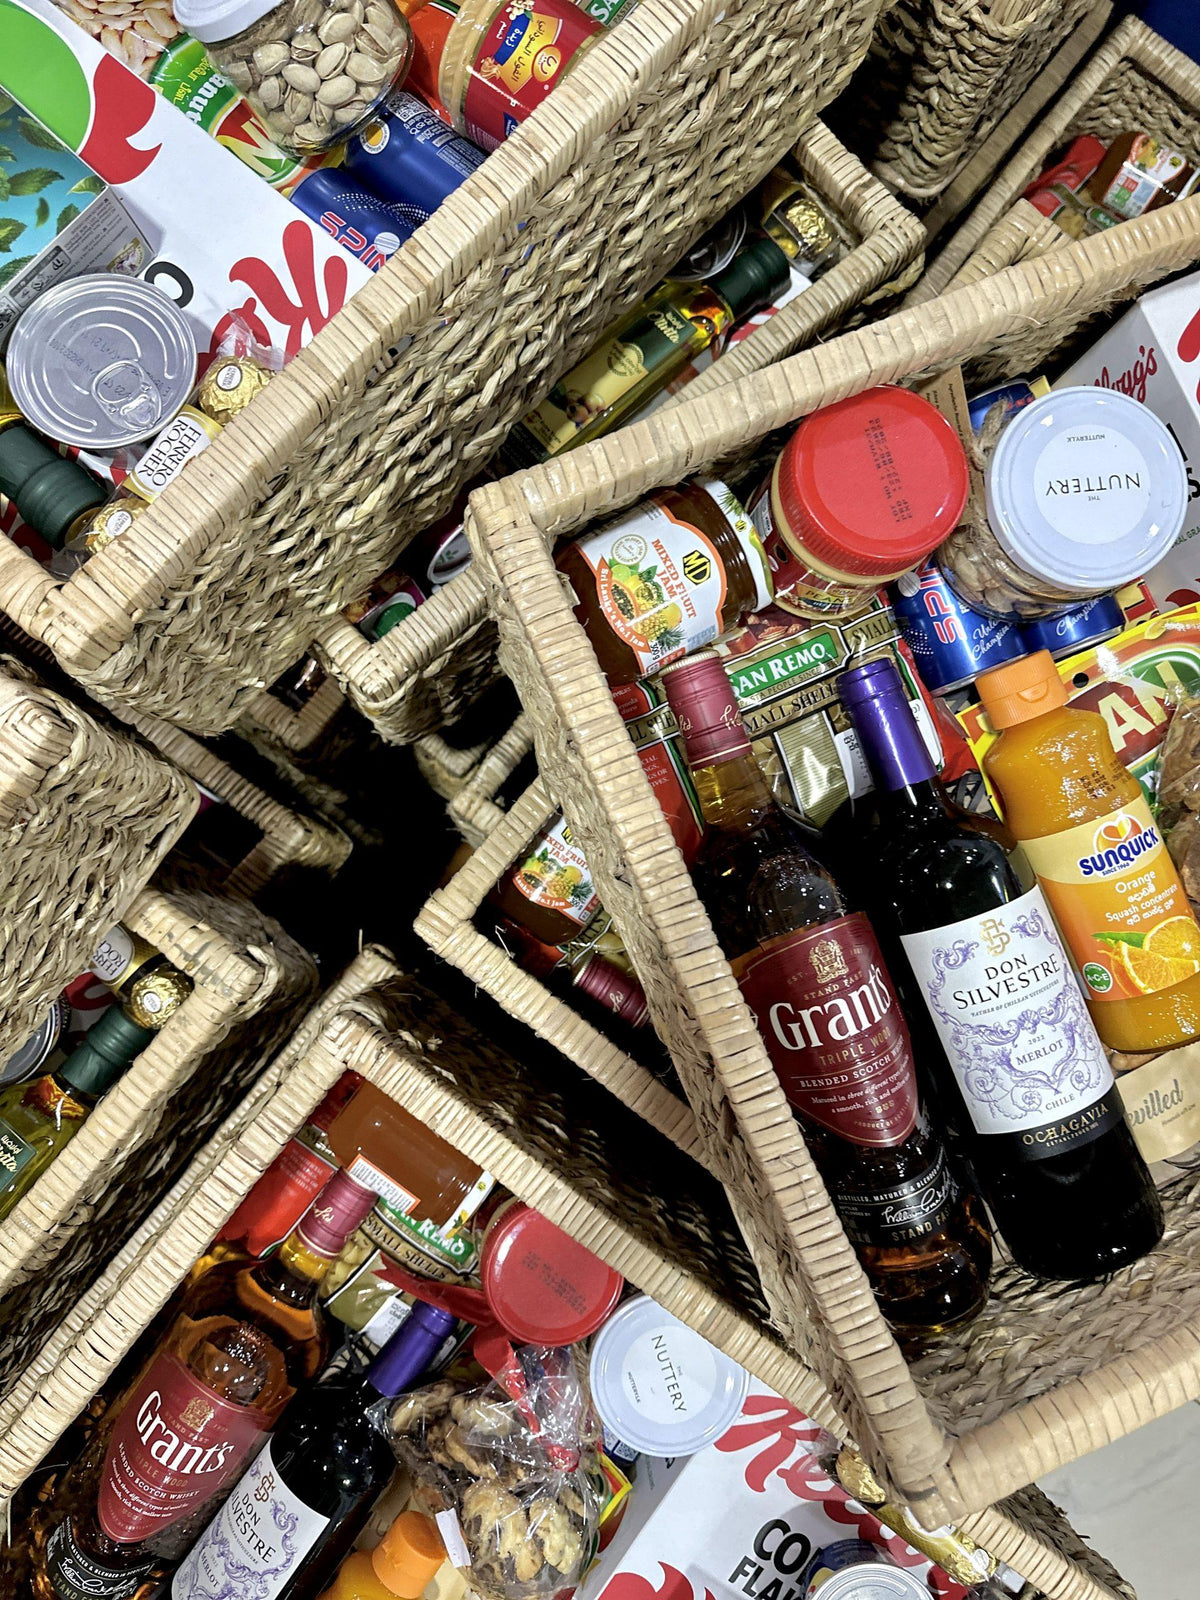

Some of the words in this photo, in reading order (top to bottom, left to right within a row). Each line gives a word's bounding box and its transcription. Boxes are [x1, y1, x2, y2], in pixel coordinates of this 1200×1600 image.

[138, 420, 190, 479] ROCHER
[153, 426, 201, 487] FERRERO
[1045, 472, 1141, 498] NUTTERY
[601, 568, 609, 583] Sri
[652, 539, 679, 581] MIXED
[675, 580, 696, 618] FRUIT
[656, 569, 677, 599] JAM
[683, 551, 711, 584] MD
[600, 583, 617, 620] Lanka's
[613, 618, 630, 636] No.1
[628, 632, 645, 647] Jam
[772, 643, 826, 678] REMO
[1080, 827, 1159, 877] SUNQUICK
[1115, 871, 1157, 893] Orange
[1105, 904, 1139, 922] Squash
[1140, 884, 1178, 911] concentrate
[953, 953, 1061, 1010] SILVESTRE
[985, 954, 1028, 980] DON
[769, 965, 891, 1050] Grant's
[803, 983, 840, 1000] STAND
[820, 1042, 863, 1066] TRIPLE
[1016, 1039, 1064, 1066] MERLOT
[801, 1072, 849, 1088] BLENDED
[853, 1055, 891, 1079] SCOTCH
[1046, 1093, 1075, 1111] CHILE
[1127, 1079, 1184, 1128] evilled
[1022, 1104, 1110, 1146] OCHAGAVIA
[873, 1186, 908, 1200] MATURED
[365, 1216, 399, 1254] SMALL
[402, 1248, 447, 1279] SHELLS
[891, 1222, 934, 1241] STAND
[651, 1335, 687, 1413] NUTTERY
[137, 1391, 234, 1475] Grant's
[135, 1478, 167, 1499] SCOTCH
[170, 1490, 200, 1500] WHISKY
[242, 1493, 260, 1525] DON
[200, 1553, 220, 1588] MERLOT
